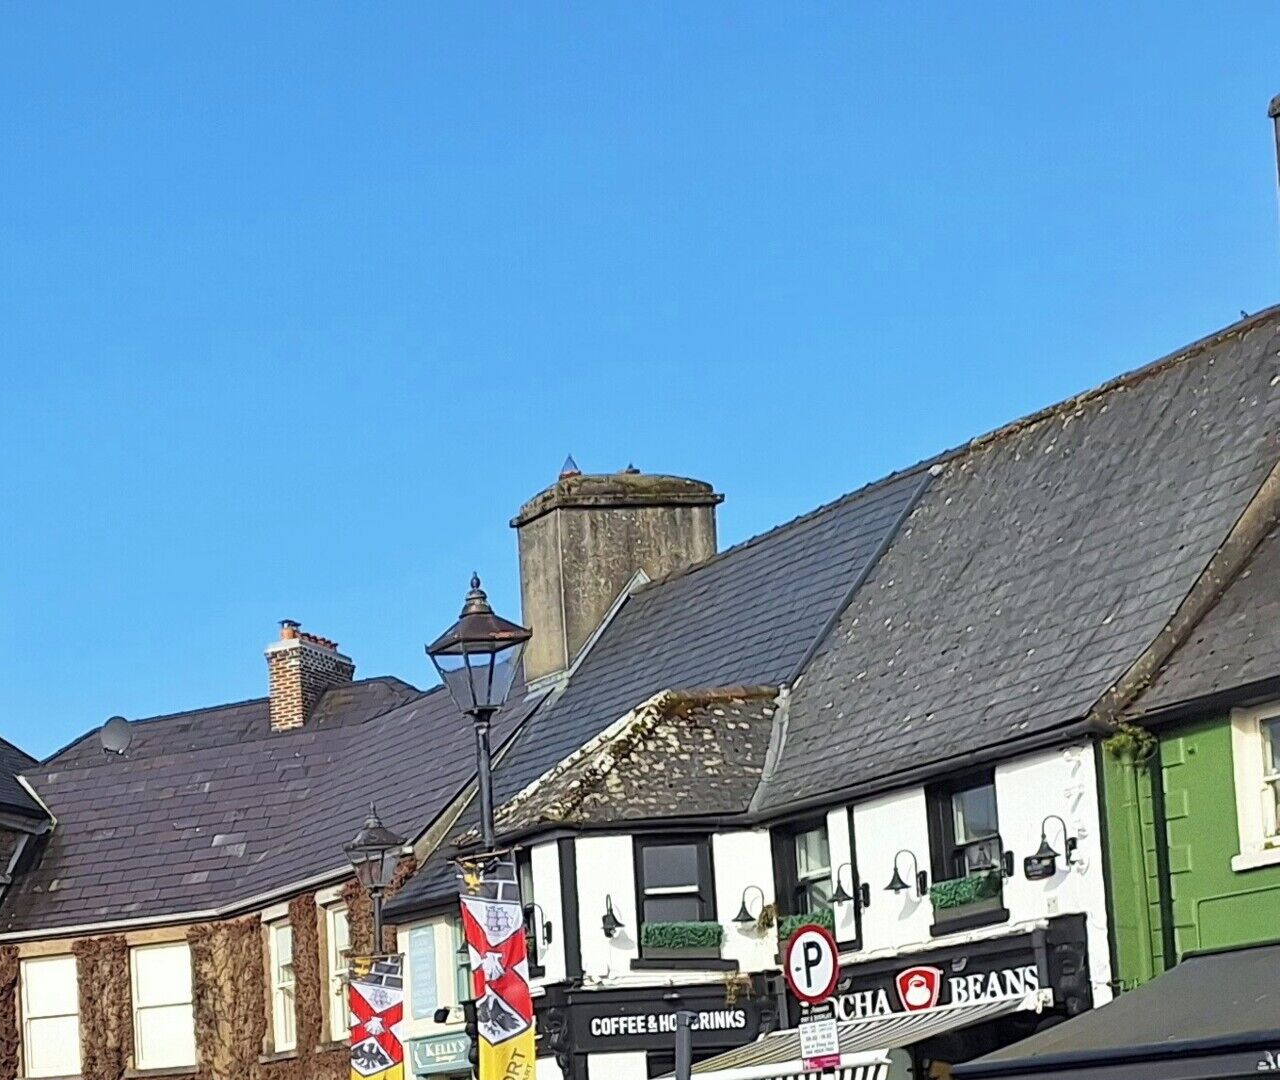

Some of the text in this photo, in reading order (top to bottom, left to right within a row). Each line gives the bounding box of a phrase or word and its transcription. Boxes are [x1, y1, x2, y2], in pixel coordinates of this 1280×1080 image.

[802, 941, 822, 988] P
[948, 965, 1039, 1004] BEANS
[591, 1017, 647, 1036] COFFEE
[659, 1016, 678, 1033] HO
